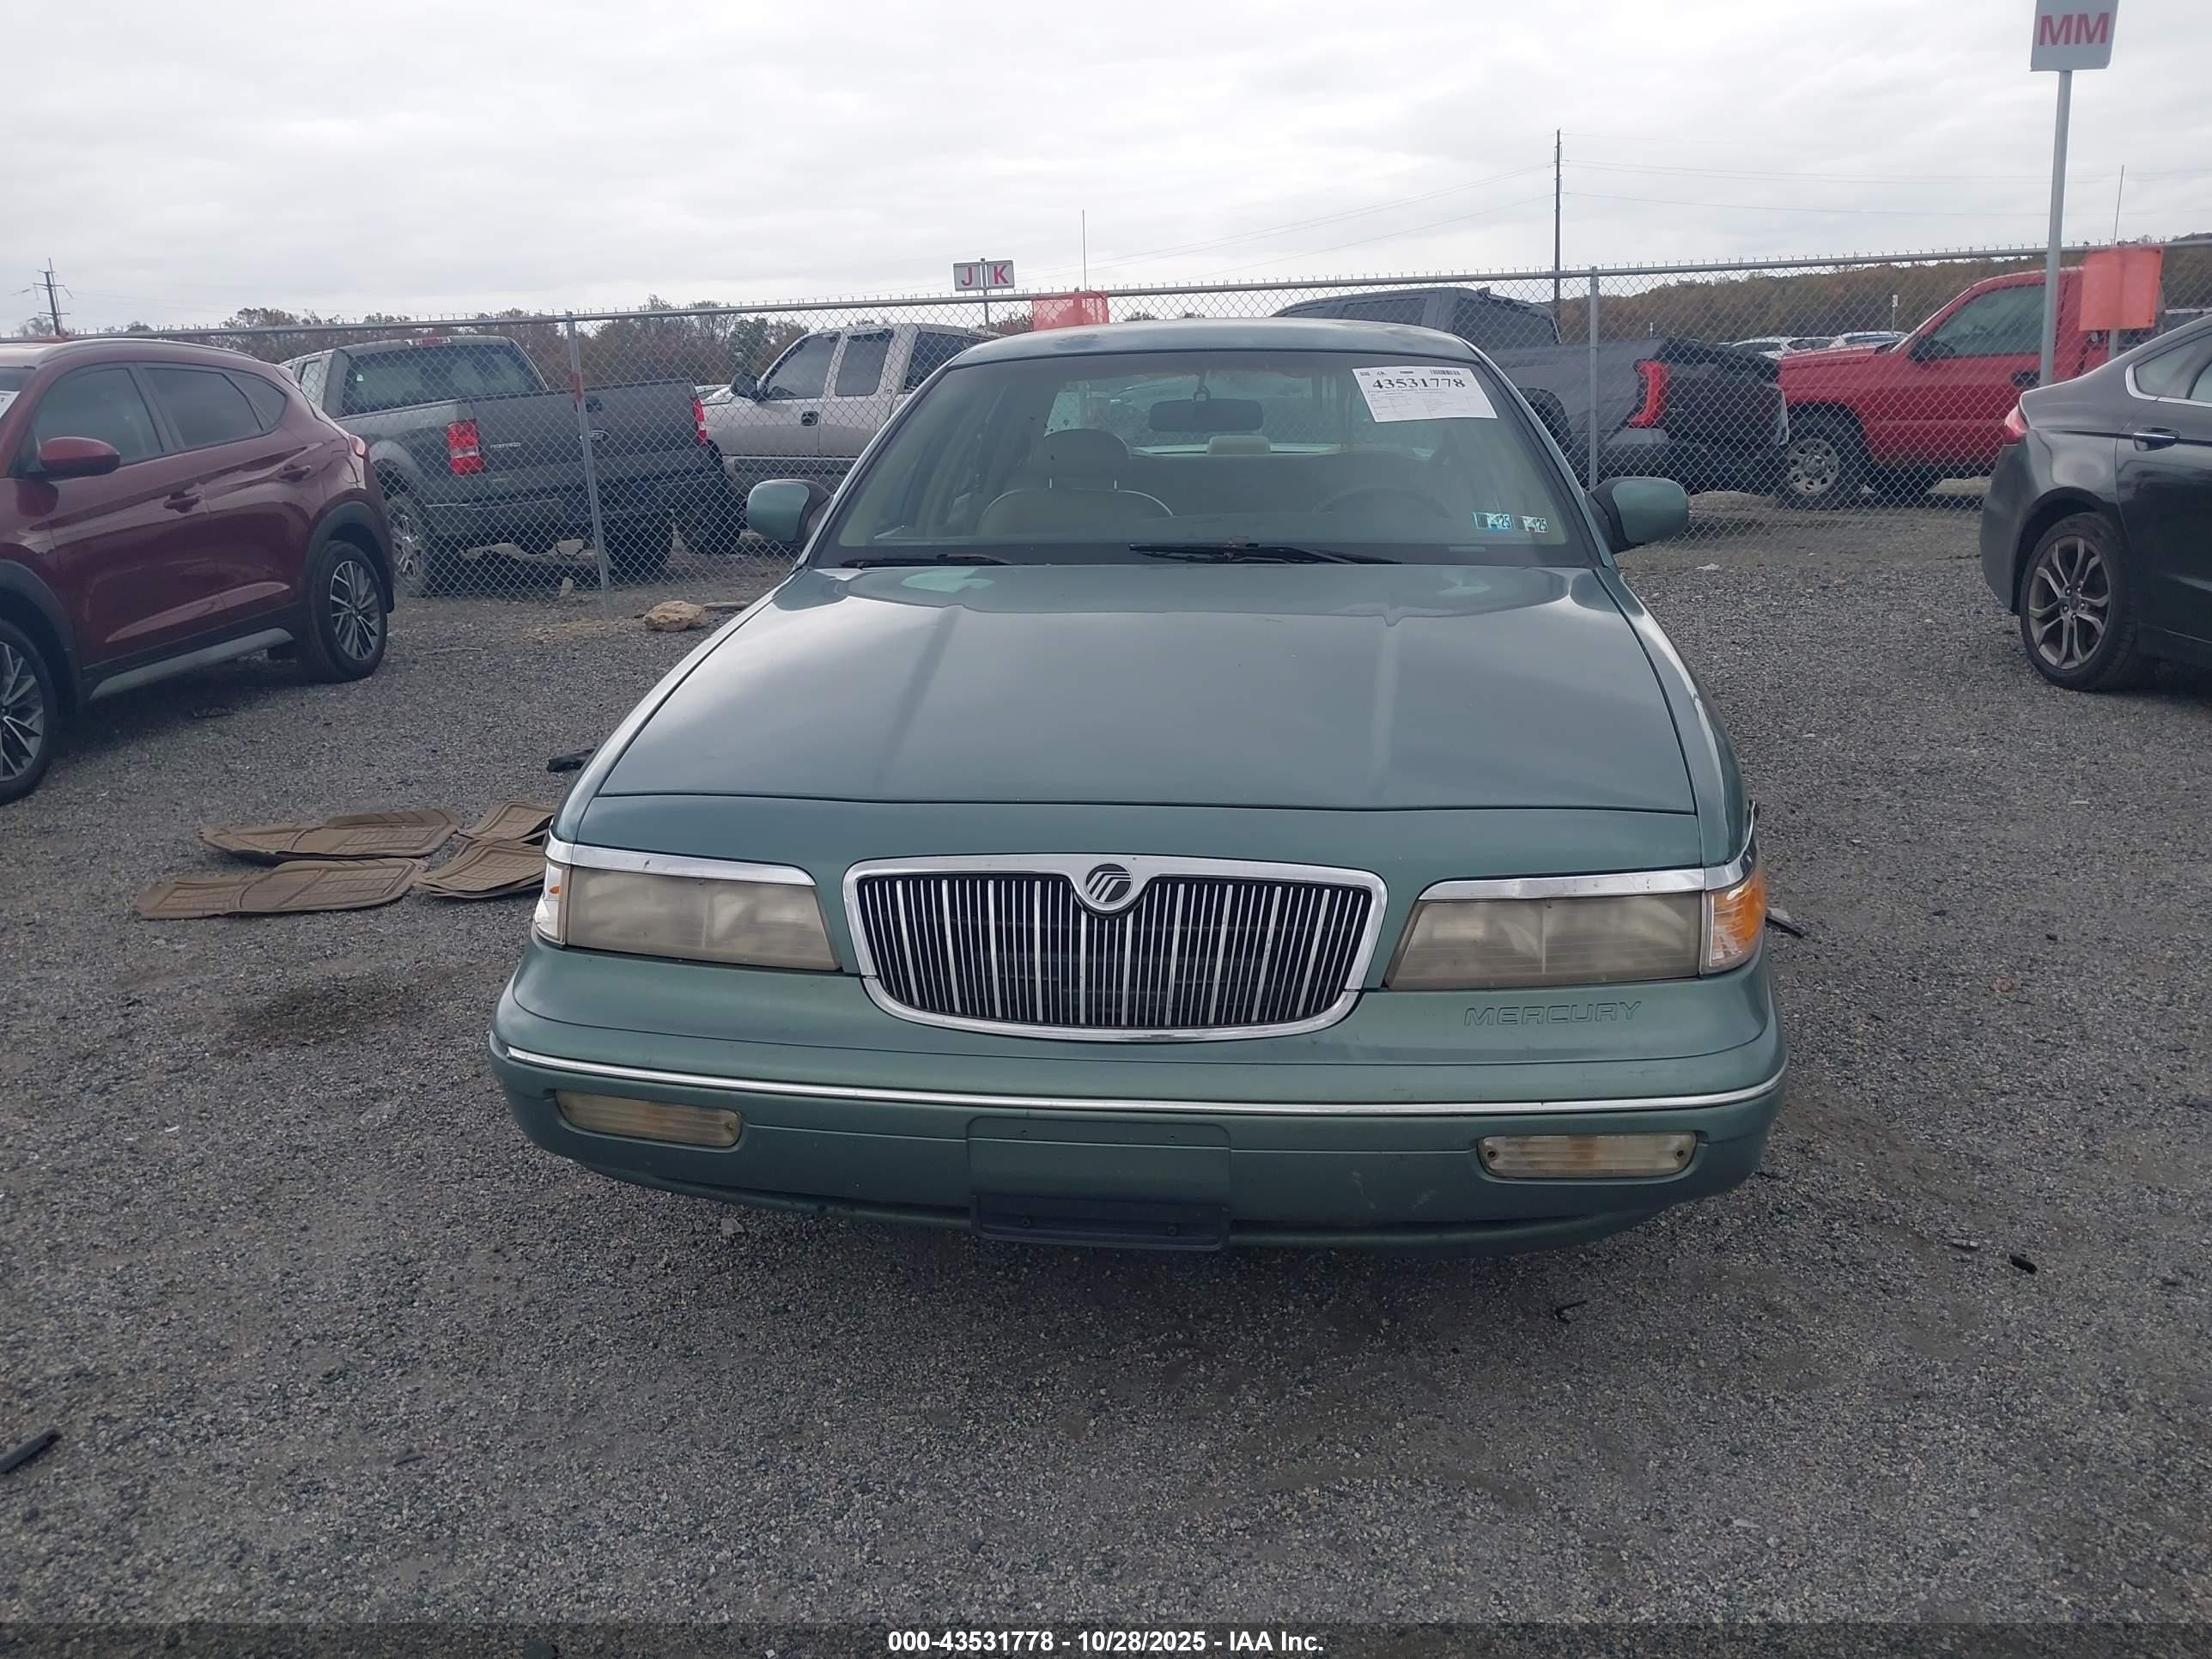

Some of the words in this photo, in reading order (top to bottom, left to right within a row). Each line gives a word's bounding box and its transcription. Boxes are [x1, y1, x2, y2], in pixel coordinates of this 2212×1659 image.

[2039, 12, 2110, 46] MM
[961, 266, 973, 287] J
[993, 264, 1009, 285] K
[1372, 377, 1466, 389] 43531778
[1463, 1000, 1642, 1027] MERCURY
